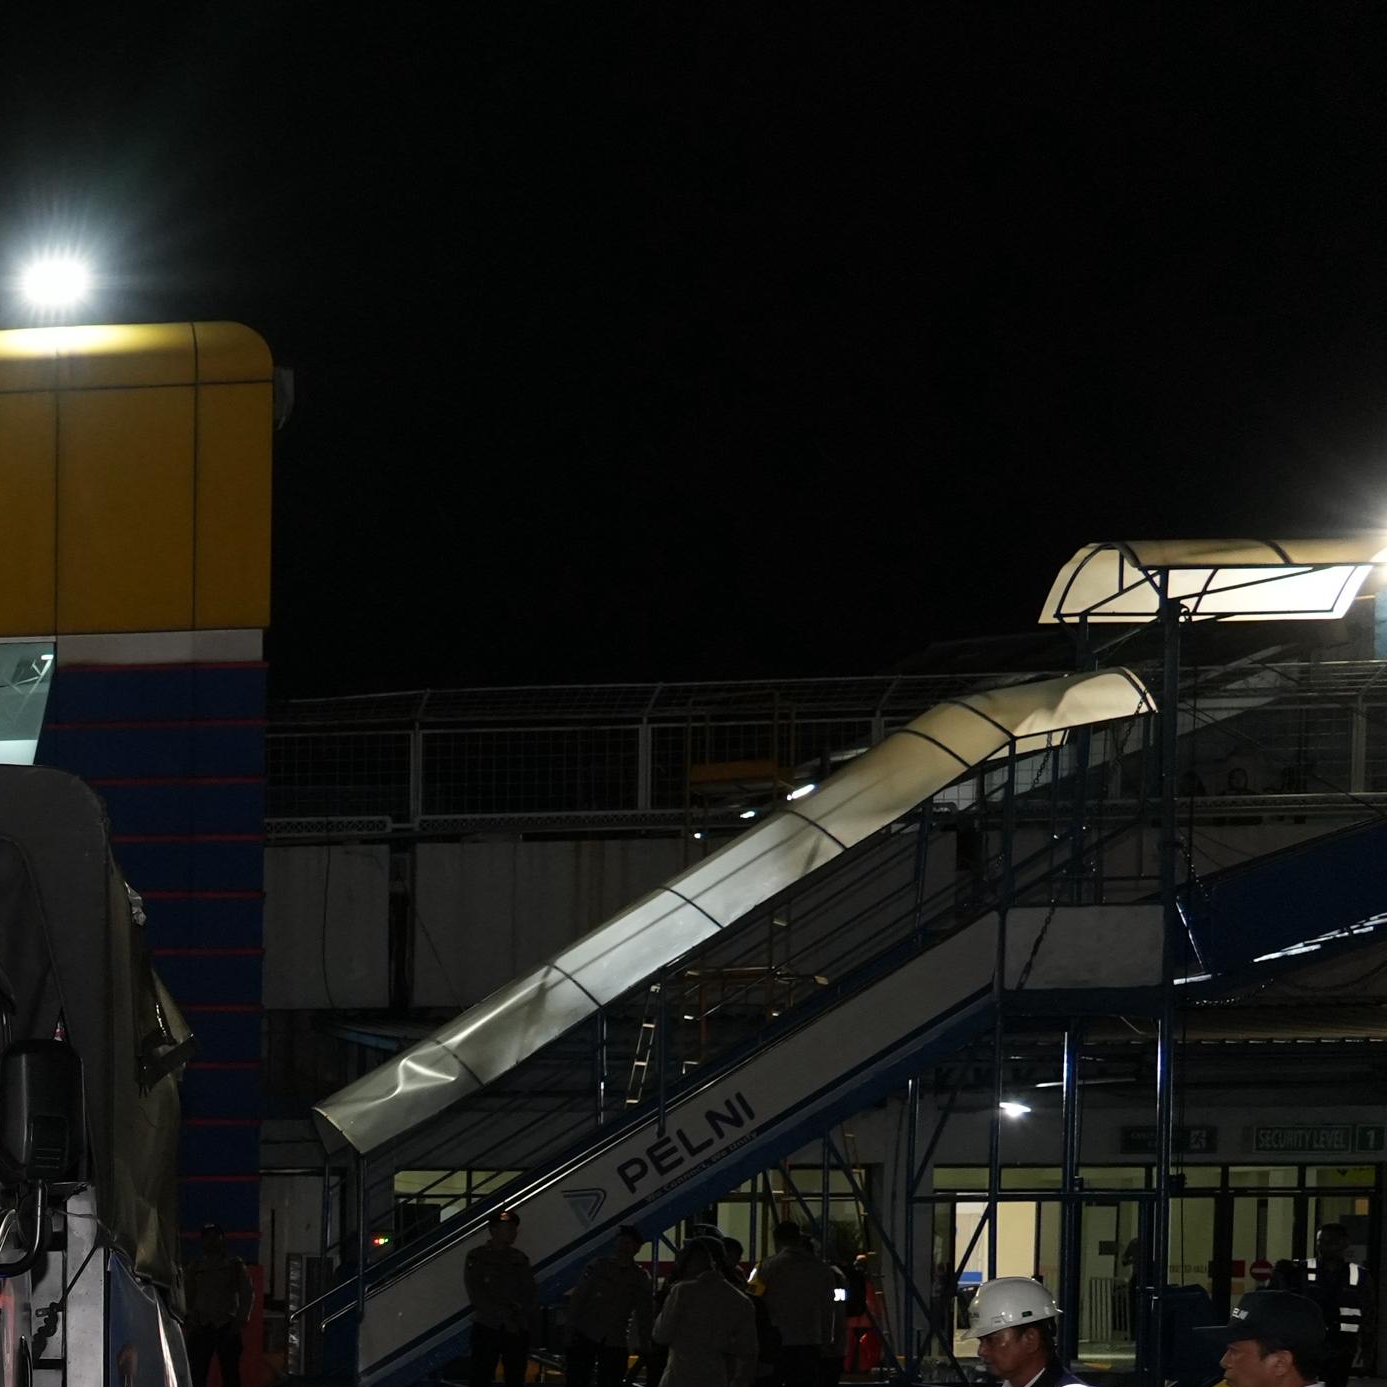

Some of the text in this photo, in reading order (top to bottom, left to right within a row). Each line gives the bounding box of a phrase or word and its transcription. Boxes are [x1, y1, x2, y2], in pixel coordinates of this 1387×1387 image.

[617, 1092, 755, 1194] PELNI
[1258, 1128, 1375, 1148] SECURITY LEVEL 1
